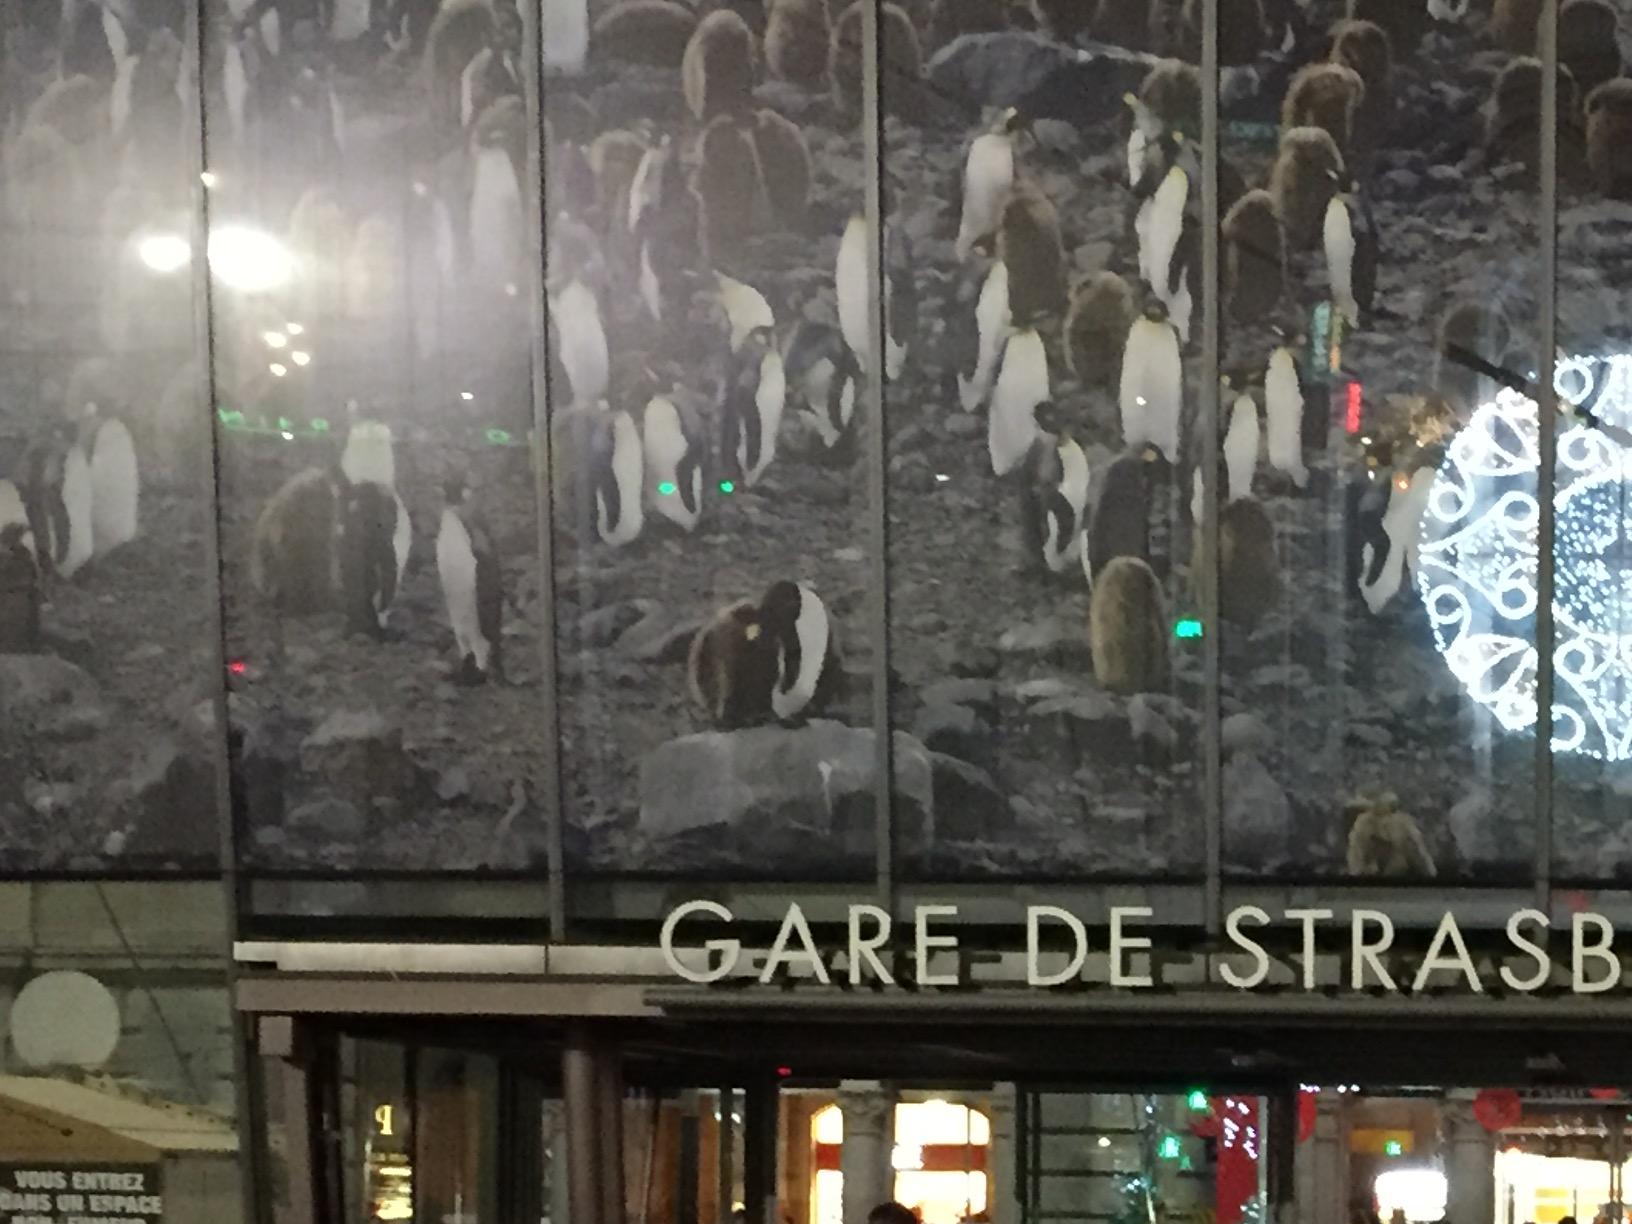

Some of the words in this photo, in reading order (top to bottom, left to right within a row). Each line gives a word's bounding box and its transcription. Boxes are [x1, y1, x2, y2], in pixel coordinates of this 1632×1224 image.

[659, 899, 960, 985] GARE
[1026, 904, 1154, 988] DE
[14, 1170, 67, 1189] VOUS
[71, 1171, 144, 1191] ENTREZ
[56, 1194, 84, 1212] UN
[88, 1194, 162, 1214] ESPACE
